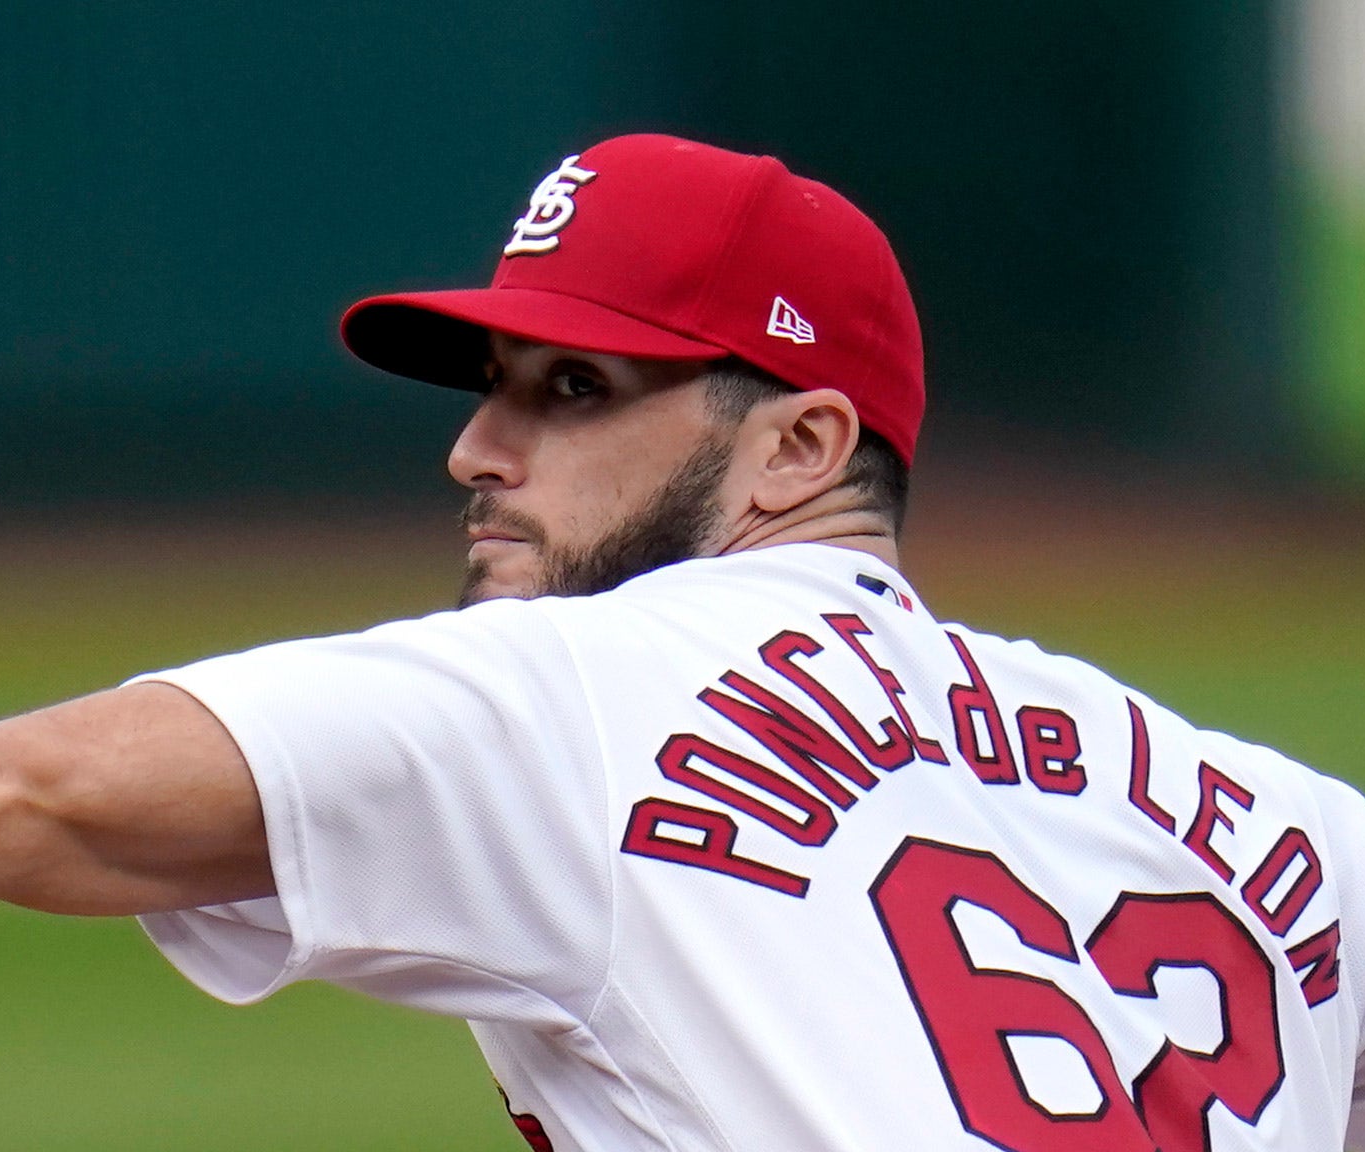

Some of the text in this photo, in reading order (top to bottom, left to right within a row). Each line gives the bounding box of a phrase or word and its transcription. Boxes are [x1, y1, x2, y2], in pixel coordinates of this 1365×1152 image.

[621, 614, 1341, 1009] PONCE de LEON
